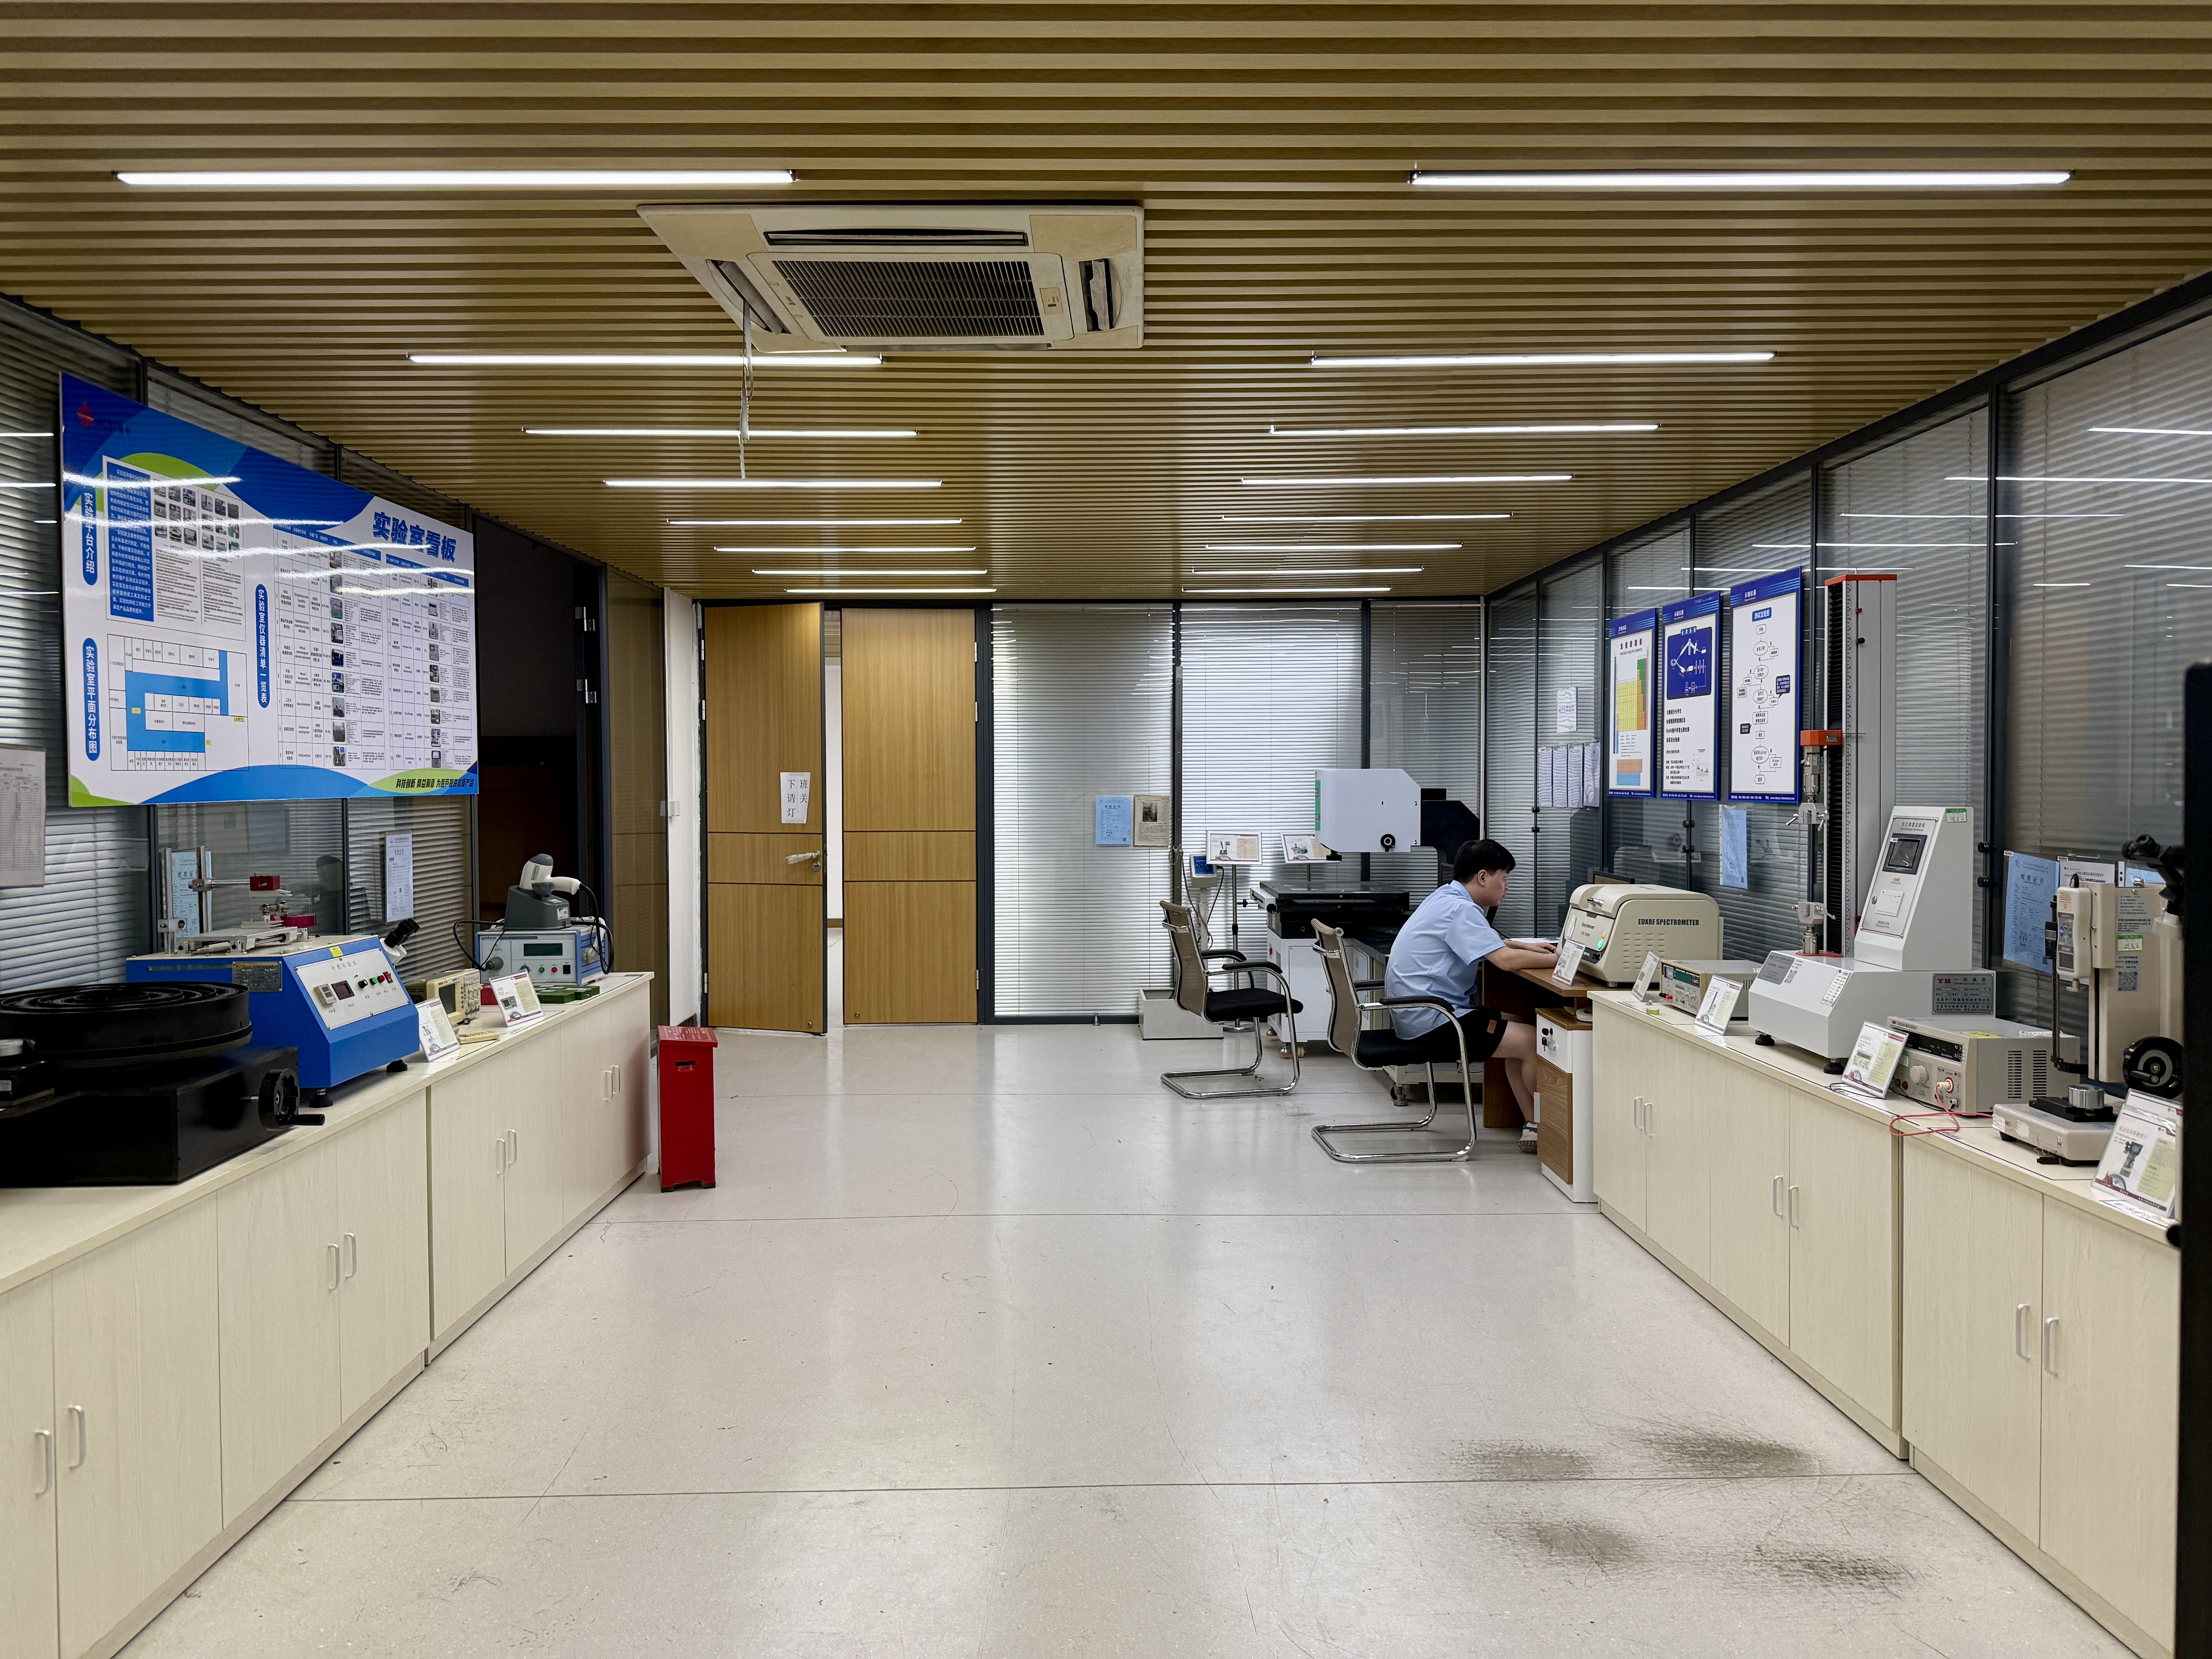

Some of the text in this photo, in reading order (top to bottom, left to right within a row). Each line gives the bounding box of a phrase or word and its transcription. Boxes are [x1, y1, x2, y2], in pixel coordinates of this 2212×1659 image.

[373, 512, 457, 563] 实验室看板
[258, 589, 268, 703] 实验室仪器清单一览表
[85, 646, 97, 754] 实验室平面分布图
[787, 779, 808, 789] 下班
[787, 793, 807, 803] 请关
[787, 808, 795, 817] 灯
